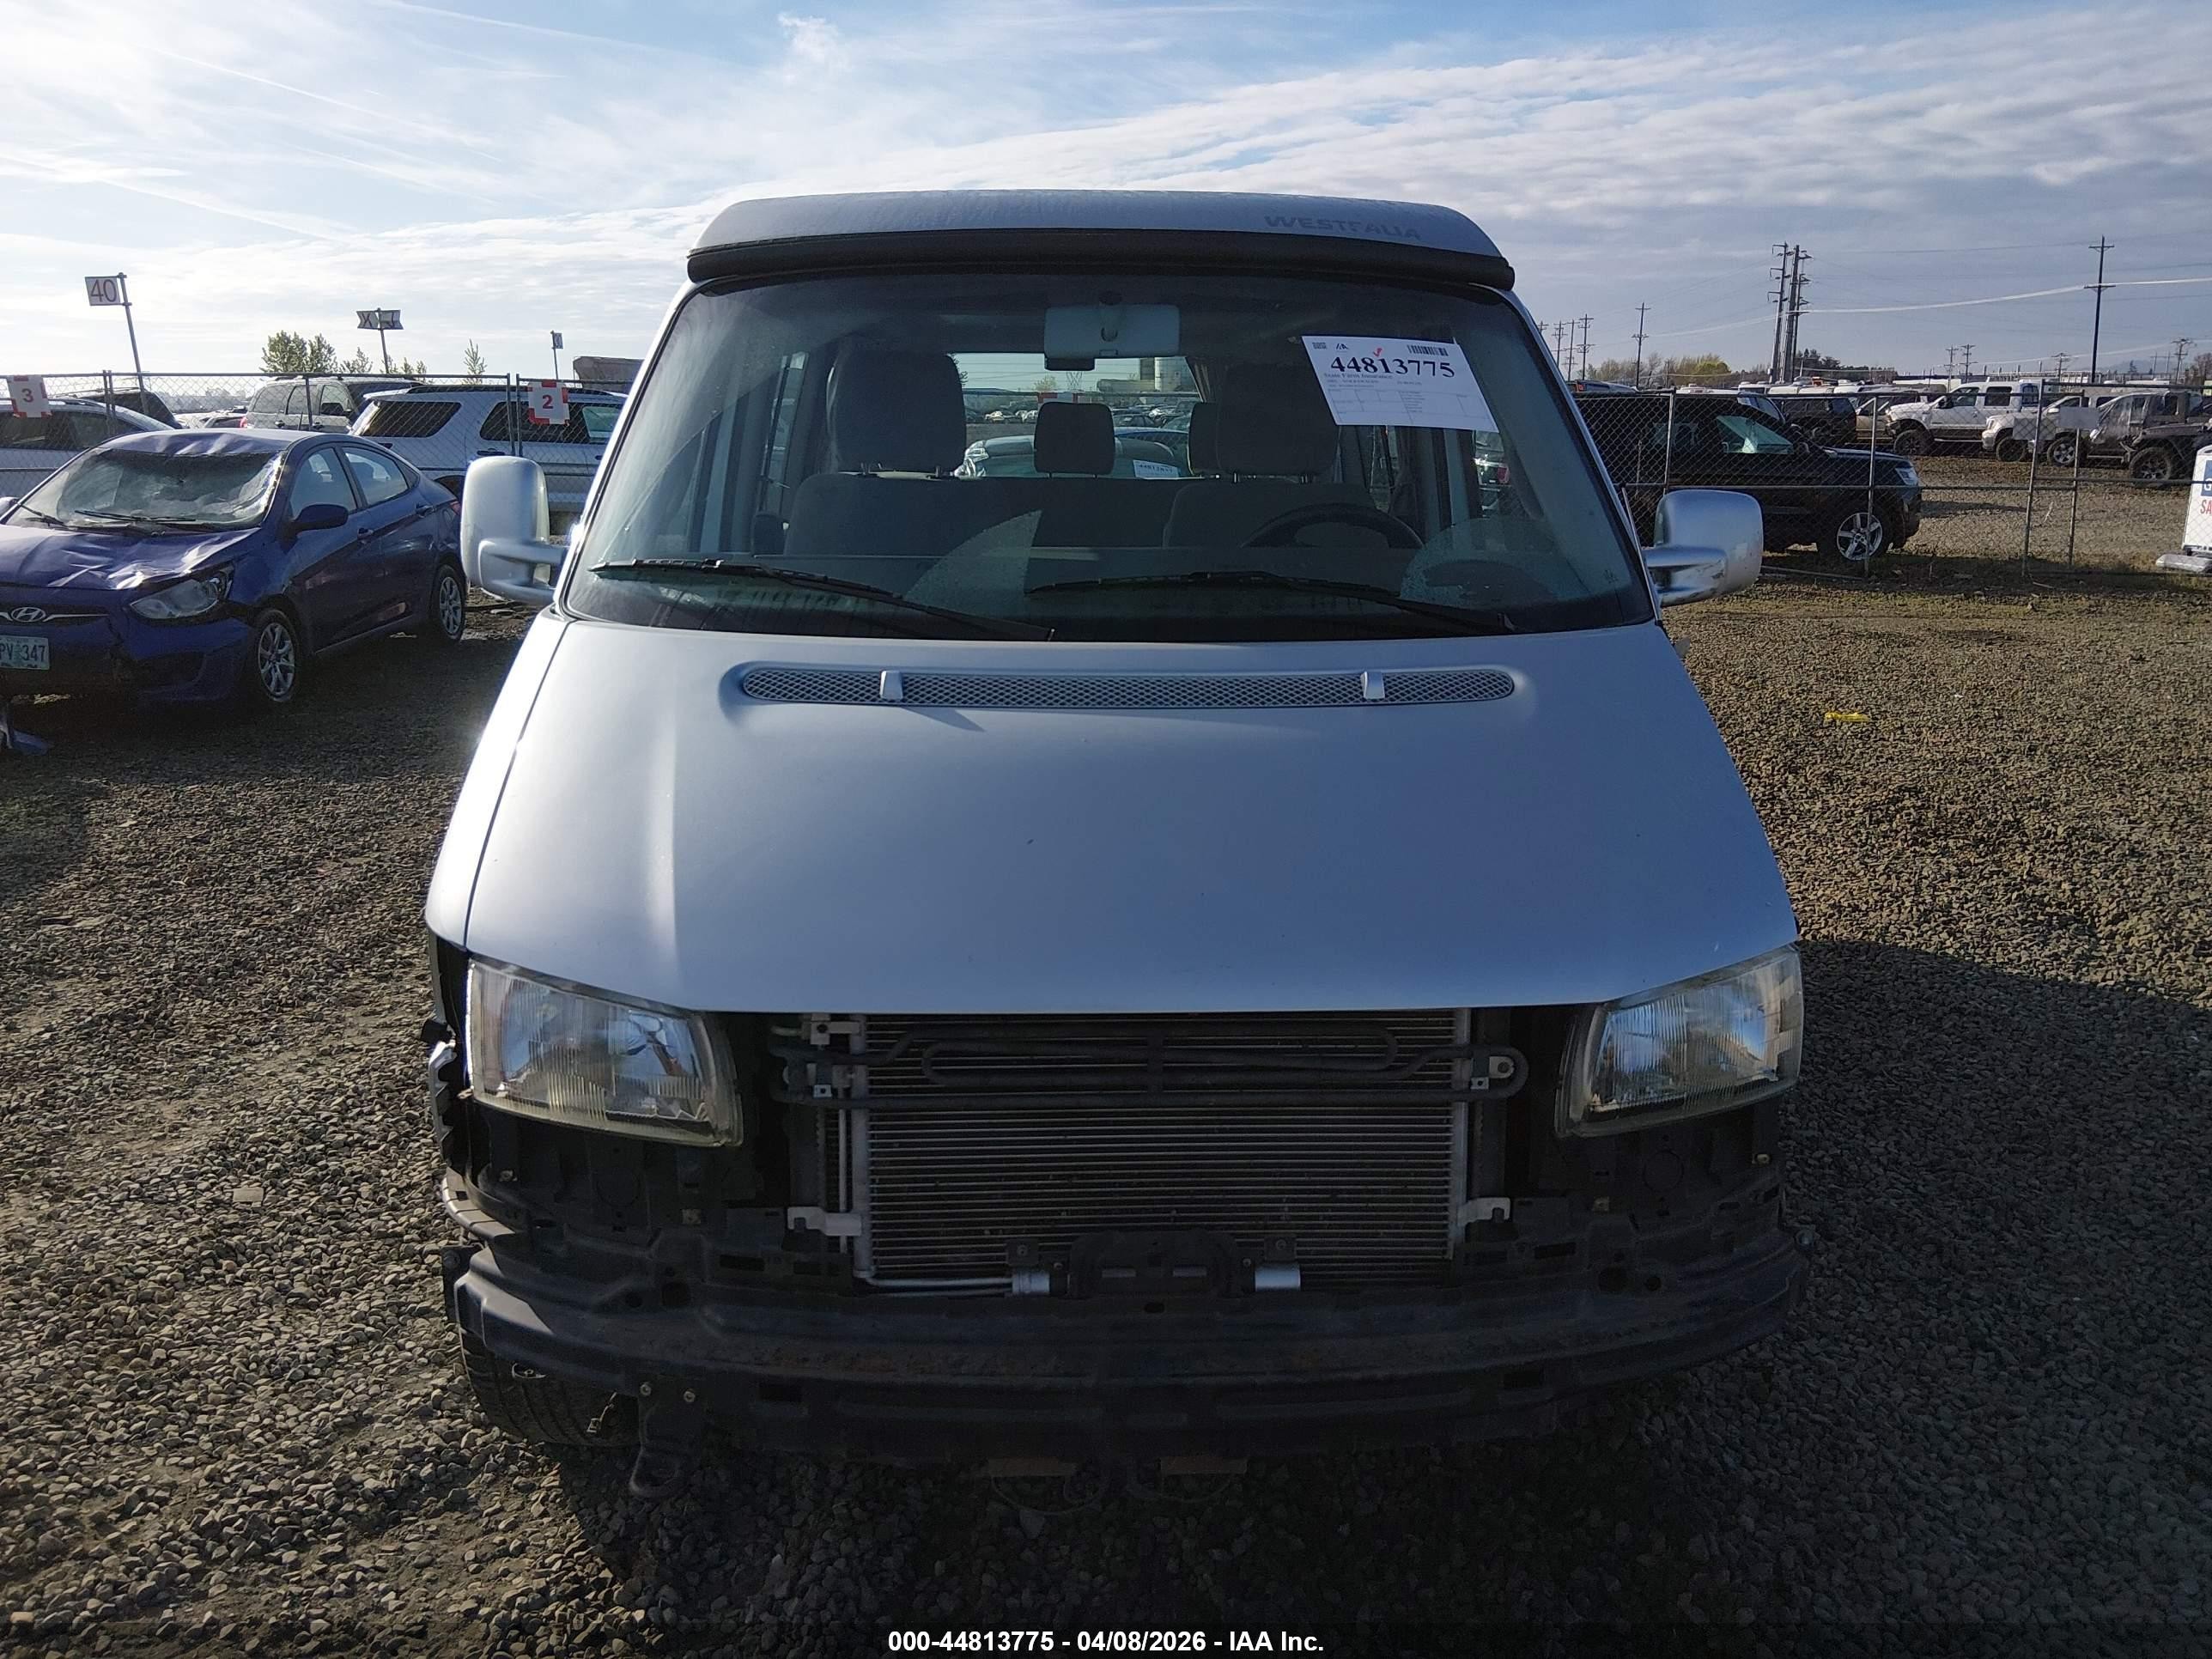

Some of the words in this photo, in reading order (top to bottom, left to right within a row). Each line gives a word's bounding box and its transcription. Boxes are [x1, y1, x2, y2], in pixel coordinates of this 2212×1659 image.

[1264, 216, 1421, 240] WESTFALIA
[90, 279, 117, 302] 40
[1331, 356, 1455, 378] 44813775
[21, 388, 33, 403] 3
[542, 394, 554, 410] 2
[21, 644, 46, 662] 347
